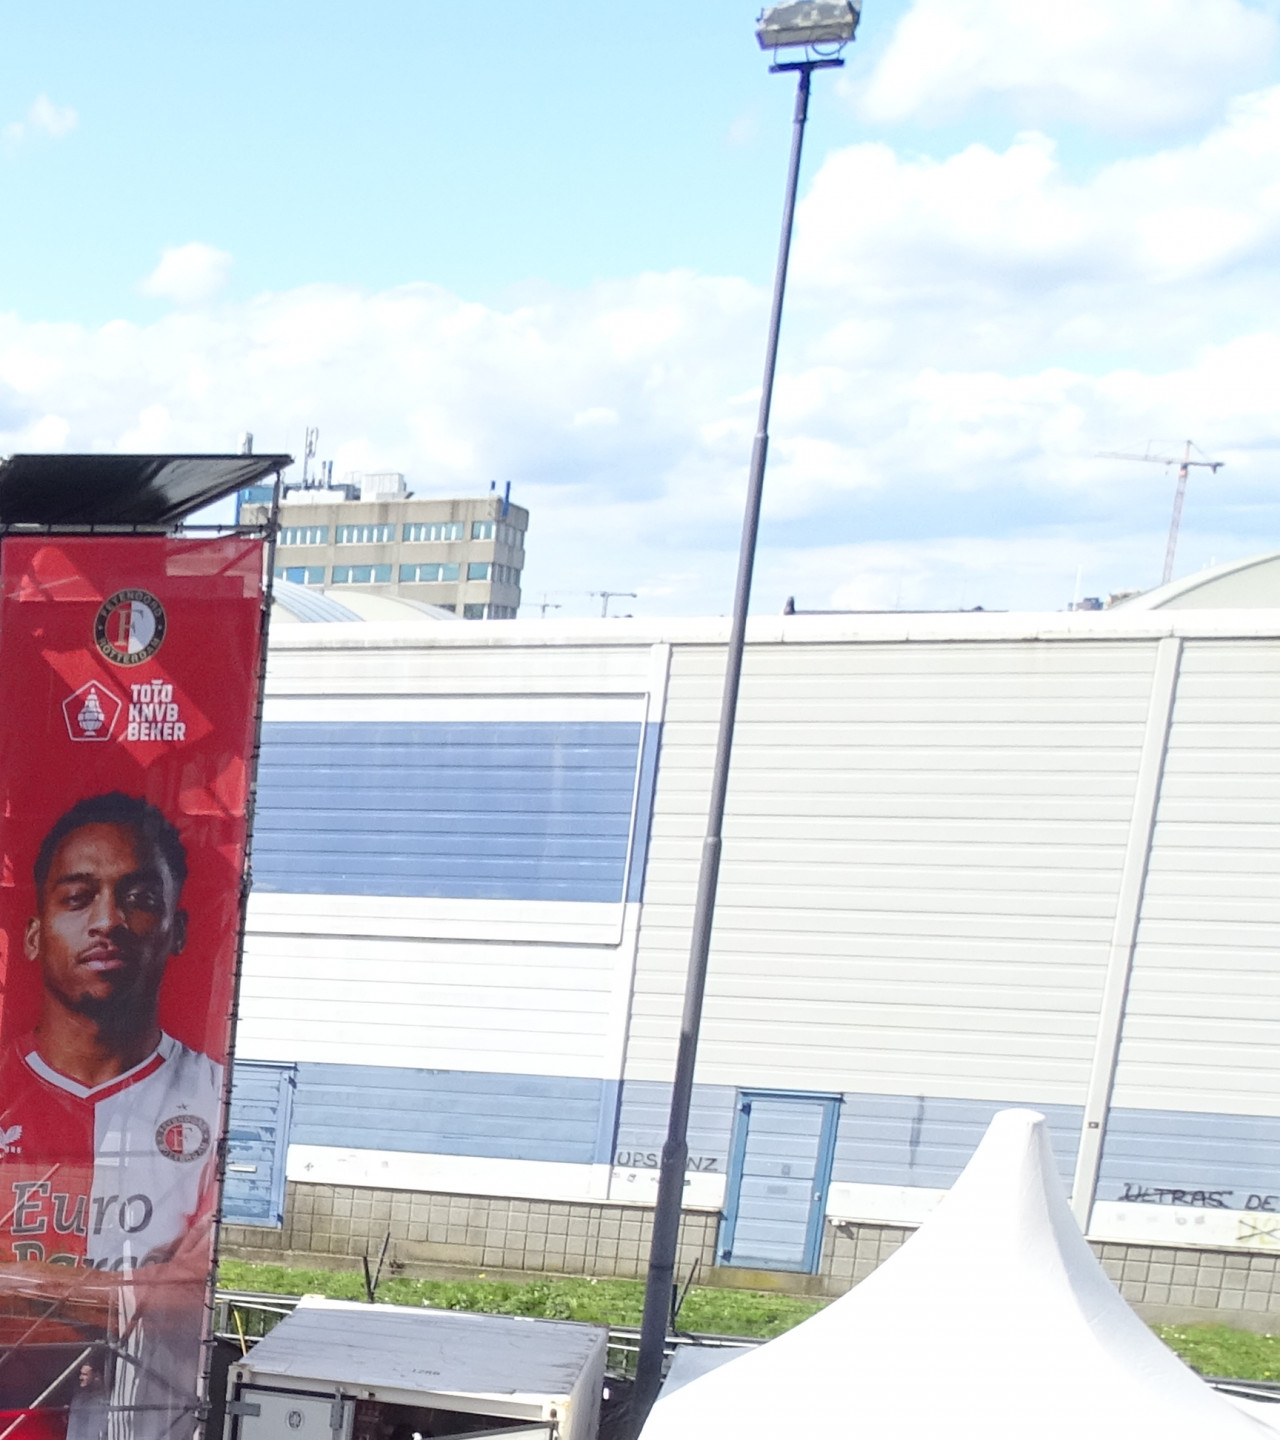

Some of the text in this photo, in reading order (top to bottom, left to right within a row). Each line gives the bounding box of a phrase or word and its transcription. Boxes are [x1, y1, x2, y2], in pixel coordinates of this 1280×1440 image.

[128, 703, 179, 722] KNVB
[127, 722, 186, 741] BEKER
[10, 1181, 154, 1236] Euro
